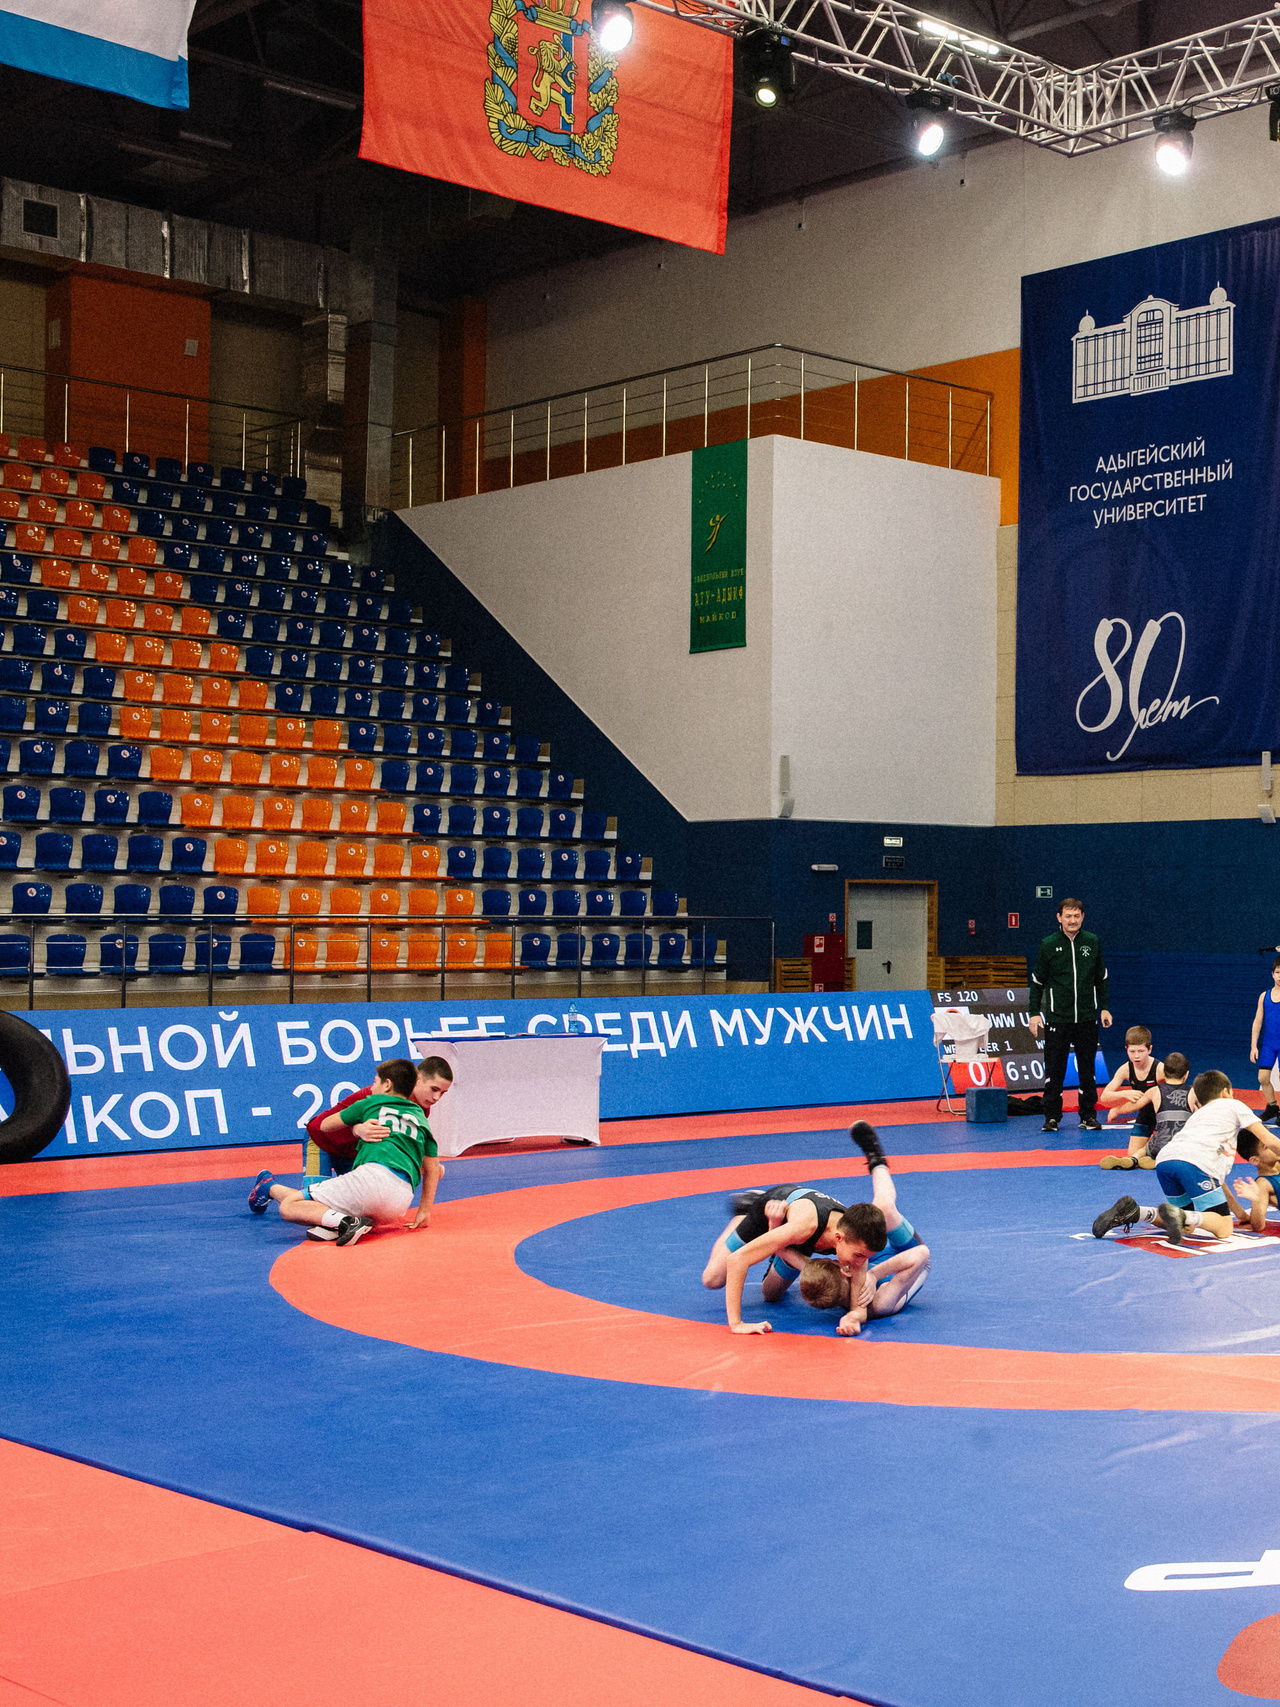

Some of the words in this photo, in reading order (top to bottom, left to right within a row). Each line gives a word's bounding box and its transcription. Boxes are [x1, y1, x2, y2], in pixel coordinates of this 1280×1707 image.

[1095, 437, 1205, 474] АДЫГЕЙСКИЙ
[1069, 459, 1233, 503] ГОСУДАРСТВЕННЫЙ
[1092, 494, 1207, 529] УНИВЕРСИТЕТ
[1076, 611, 1186, 733] 80
[937, 992, 952, 1003] FS
[957, 990, 978, 1002] 120
[1006, 989, 1015, 1002] 0
[38, 1011, 256, 1076] ЬНОЙ
[709, 1003, 914, 1047] МУЖЧИН
[968, 1061, 987, 1087] 0
[1006, 1059, 1045, 1081] 6:0
[64, 1088, 228, 1144] КОП
